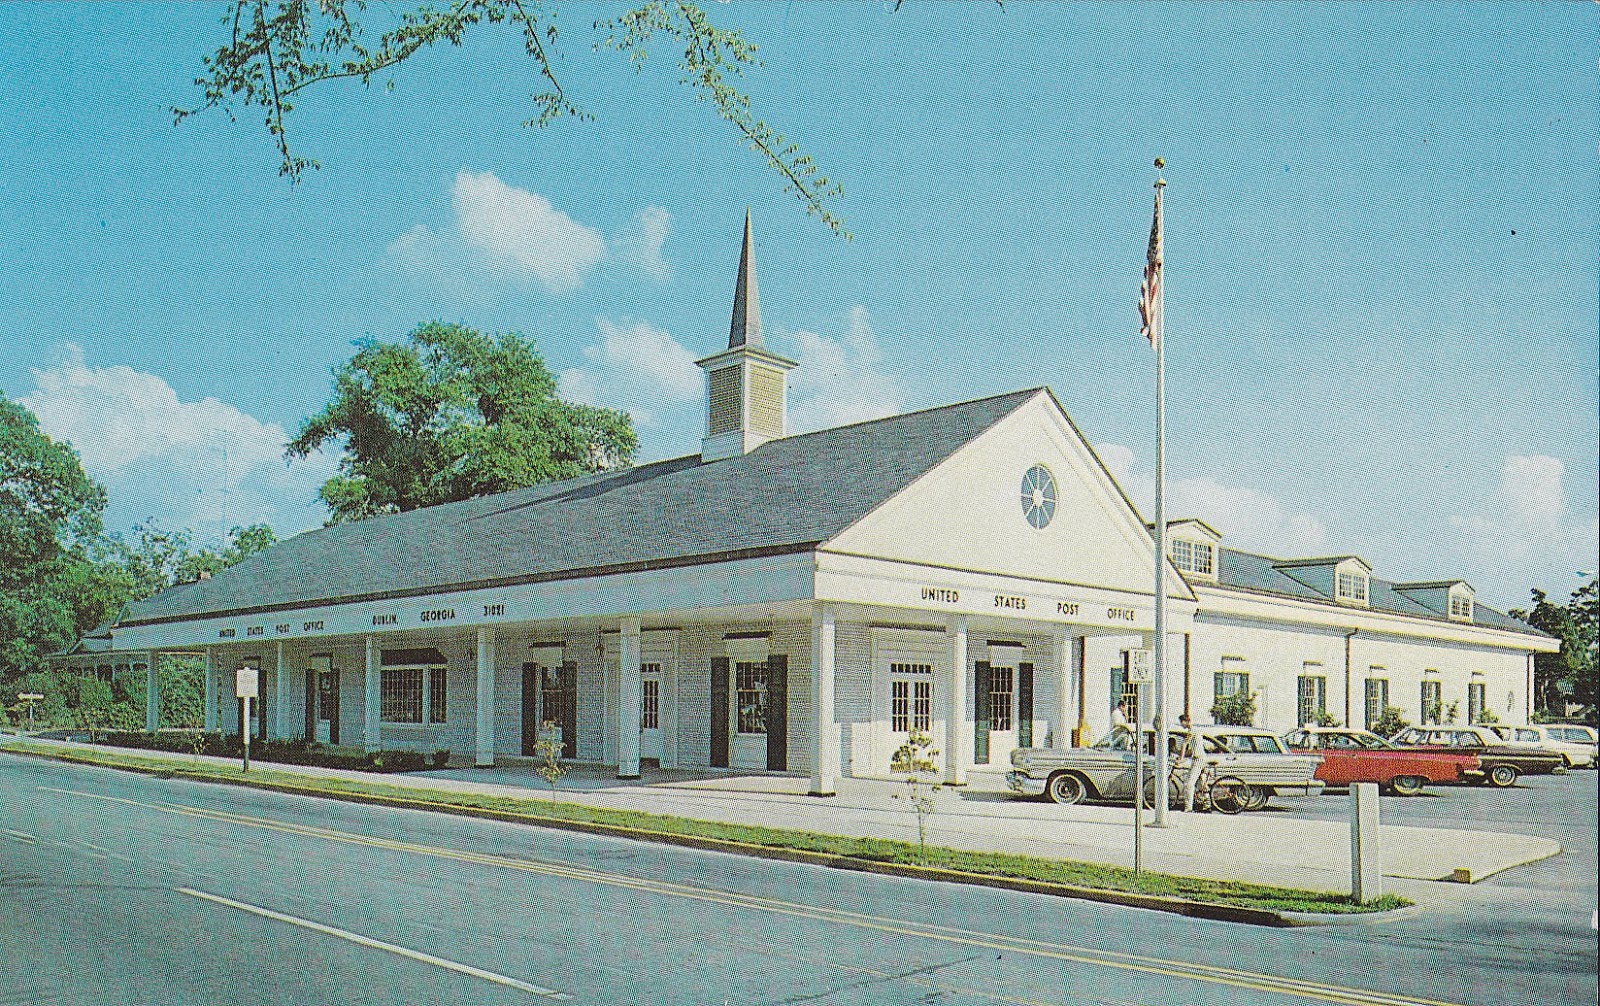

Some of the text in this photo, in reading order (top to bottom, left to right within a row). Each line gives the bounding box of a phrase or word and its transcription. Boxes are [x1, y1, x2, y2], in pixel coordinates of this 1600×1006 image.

[921, 586, 1135, 621] UNITED STATES POST OFFICE
[420, 609, 456, 622] GEORGIA
[303, 620, 325, 632] OFFICE
